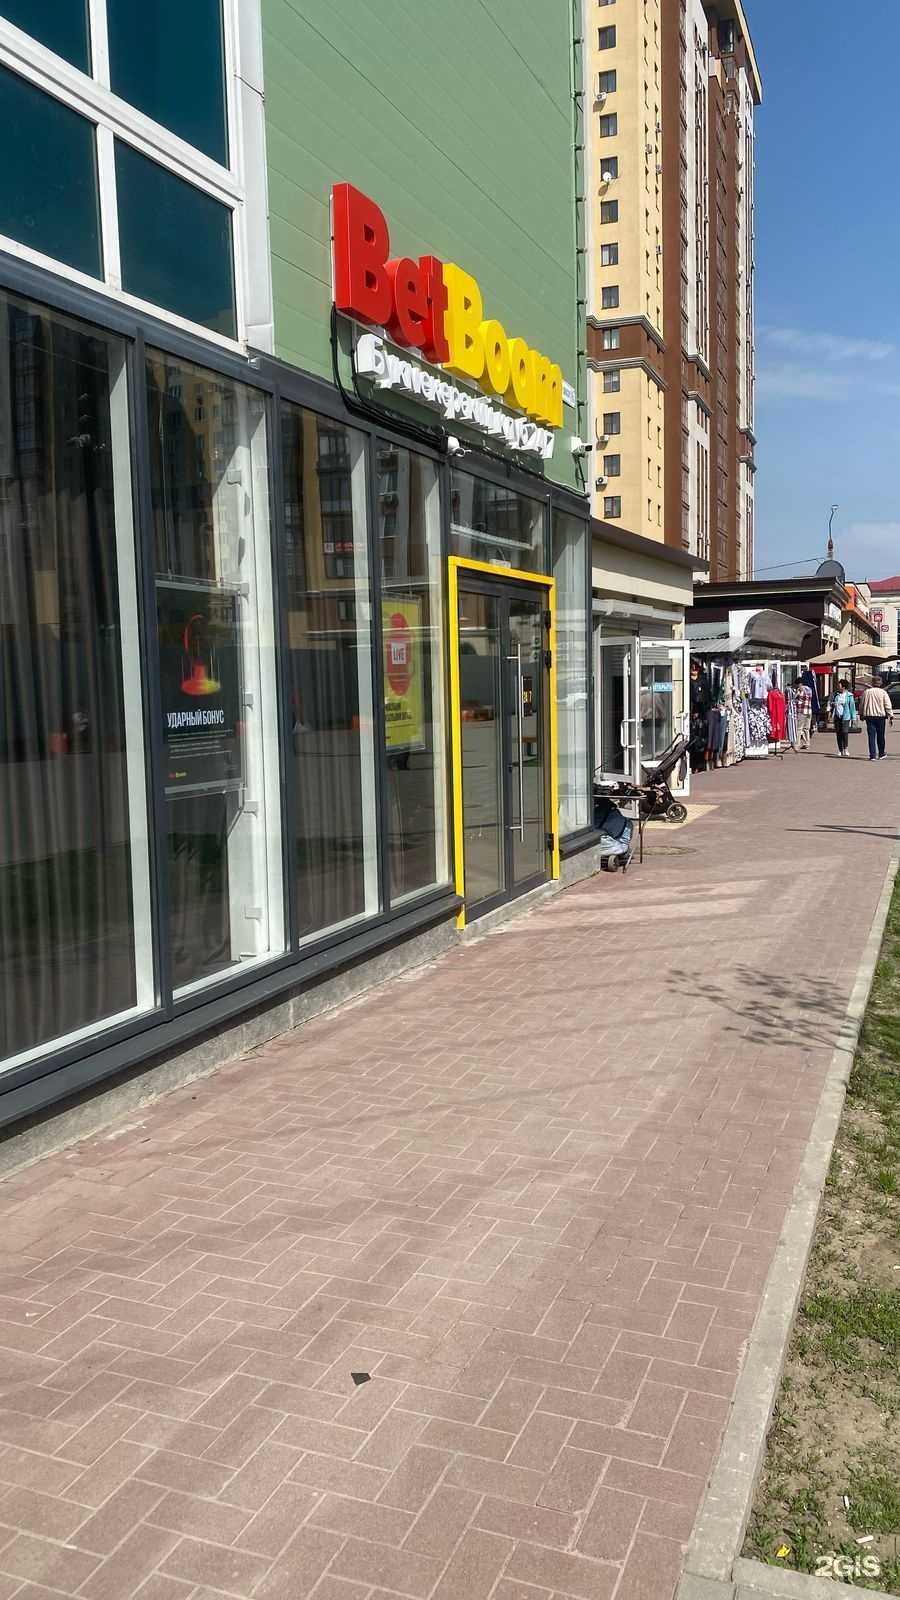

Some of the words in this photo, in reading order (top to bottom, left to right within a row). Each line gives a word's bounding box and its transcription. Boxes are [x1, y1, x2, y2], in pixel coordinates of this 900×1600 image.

[331, 182, 564, 430] BetBoom
[167, 708, 202, 729] УДАРНЫЙ
[203, 709, 225, 725] БОНУС
